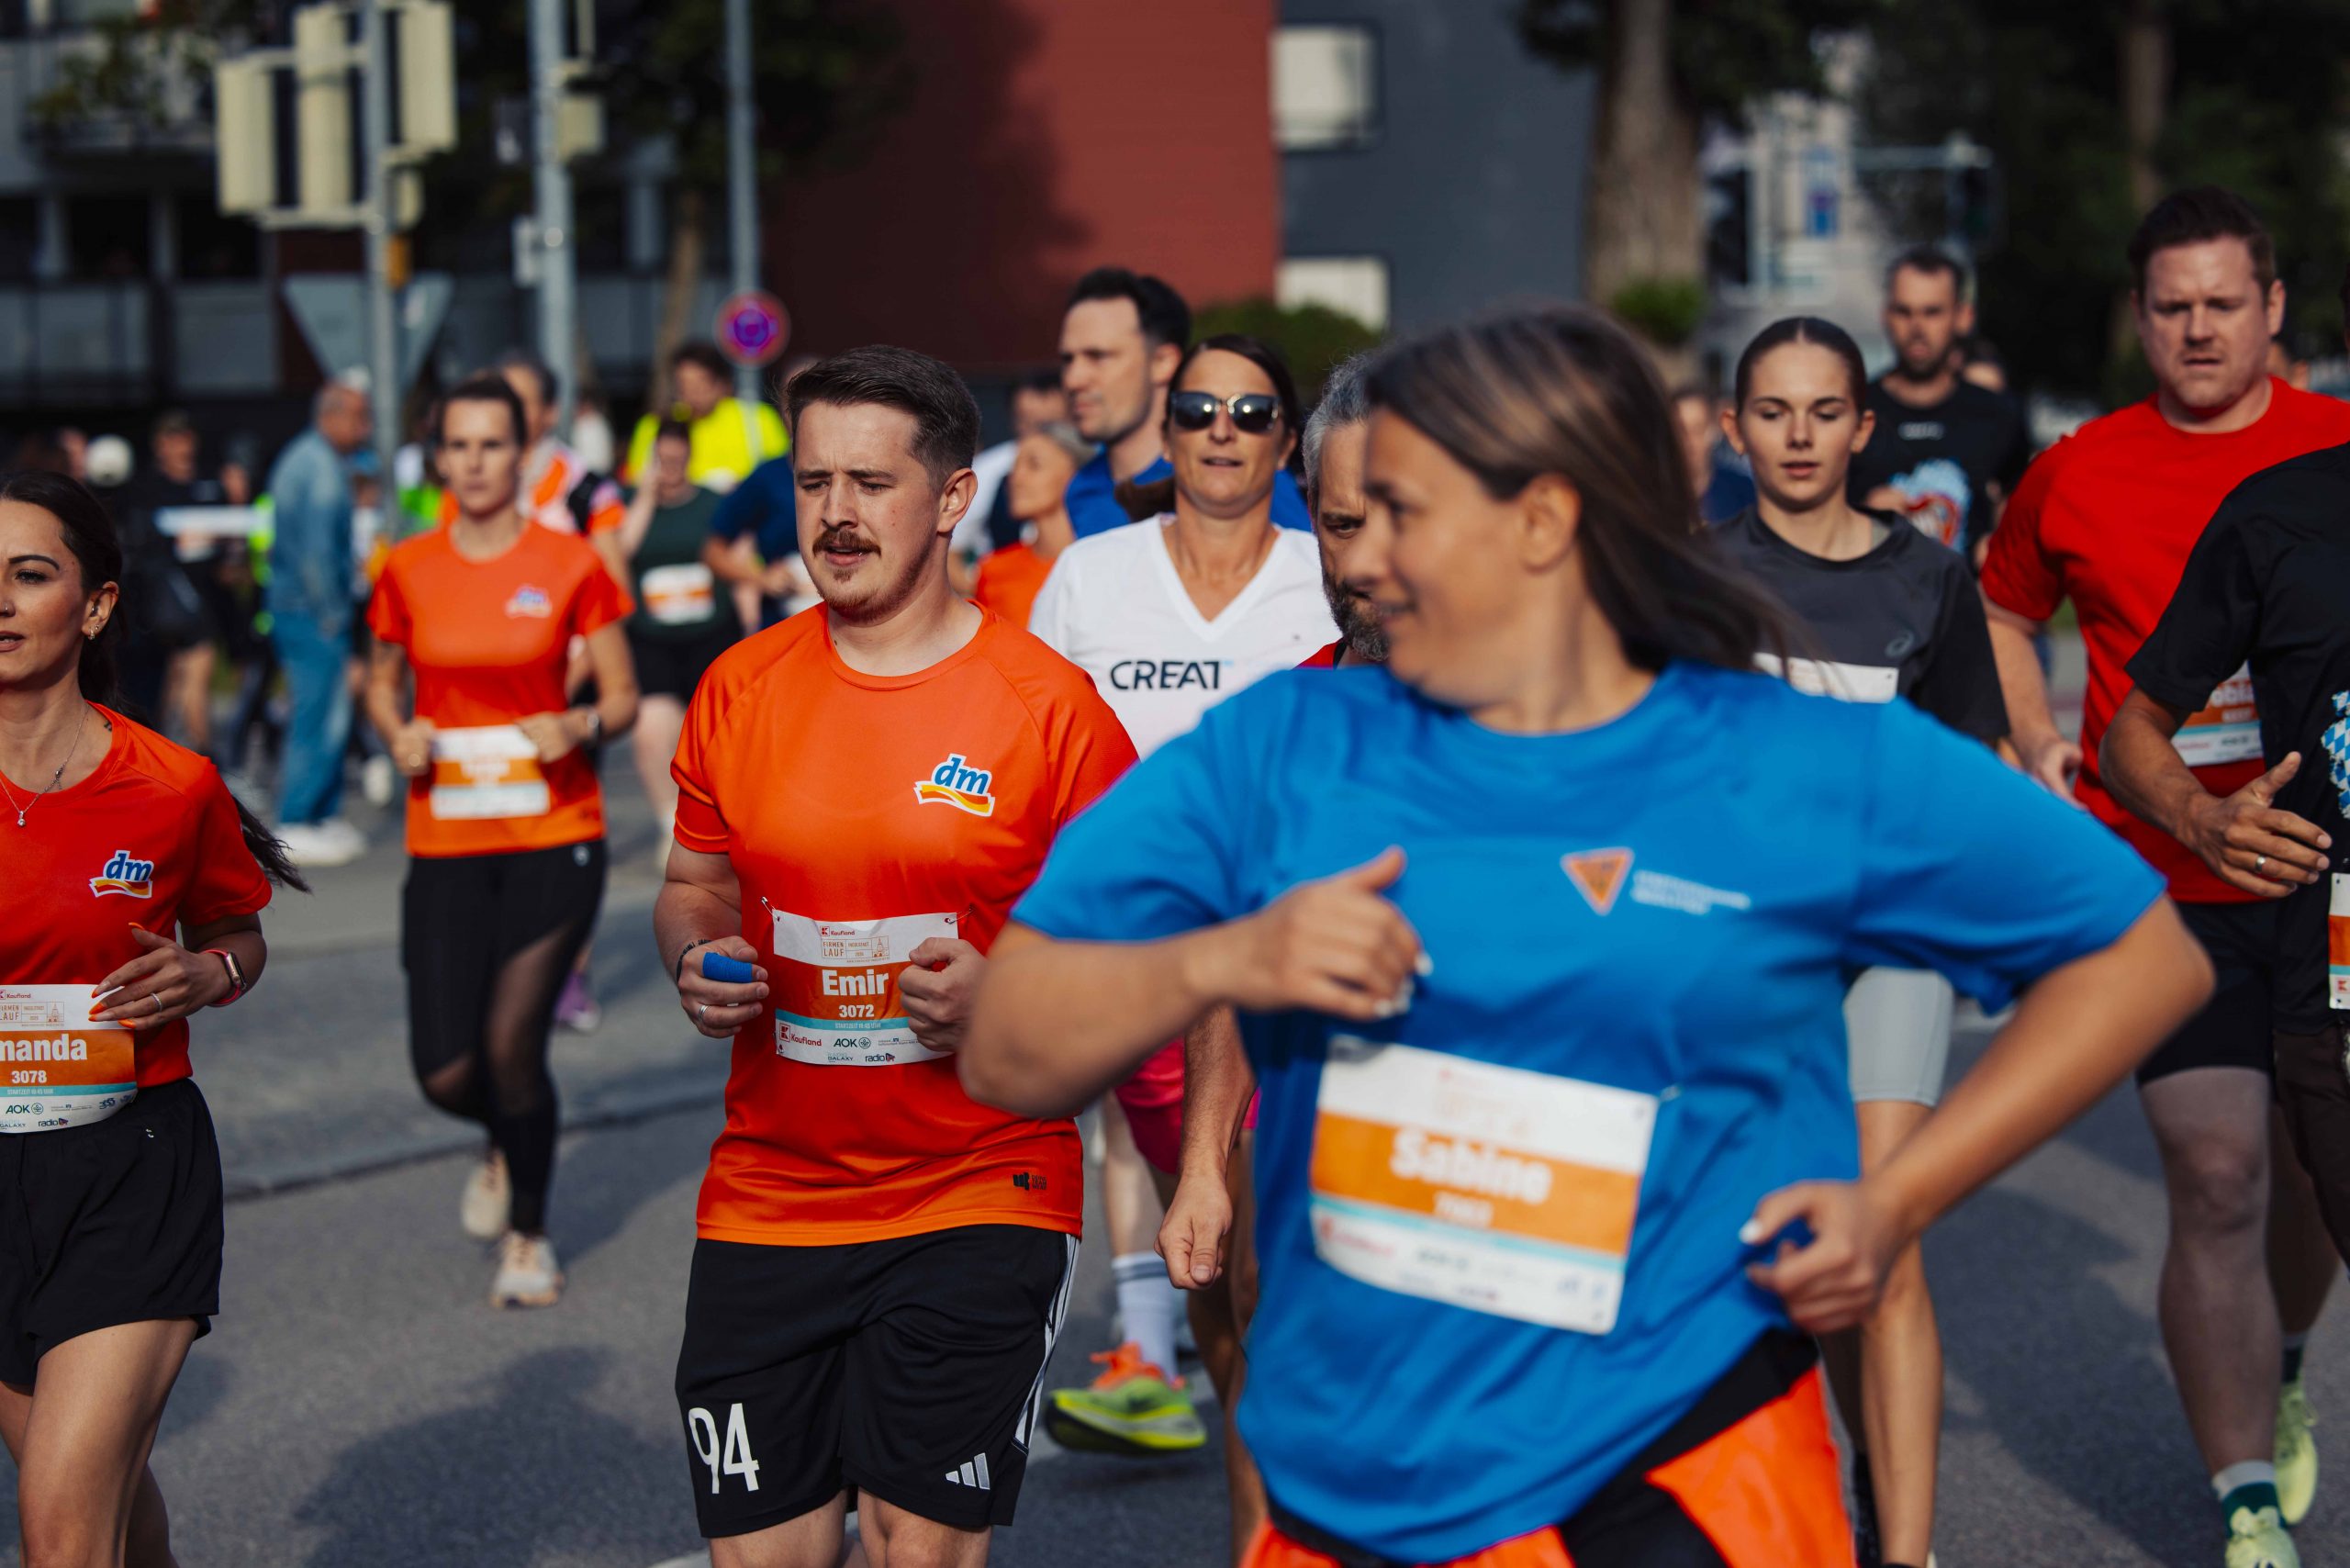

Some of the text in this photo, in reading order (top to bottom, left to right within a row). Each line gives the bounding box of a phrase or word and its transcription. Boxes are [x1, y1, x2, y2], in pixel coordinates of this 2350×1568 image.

[934, 756, 990, 795] dm
[106, 852, 152, 880] dm
[823, 948, 845, 957] LAUF
[822, 969, 889, 997] Emir
[838, 1003, 875, 1018] 3072
[790, 1033, 822, 1047] Kaufland
[834, 1037, 857, 1048] AOK
[865, 1053, 885, 1062] radio
[11, 1070, 48, 1084] 3078
[6, 1103, 30, 1114] AOK
[38, 1118, 59, 1127] radio
[688, 1403, 760, 1495] 94
